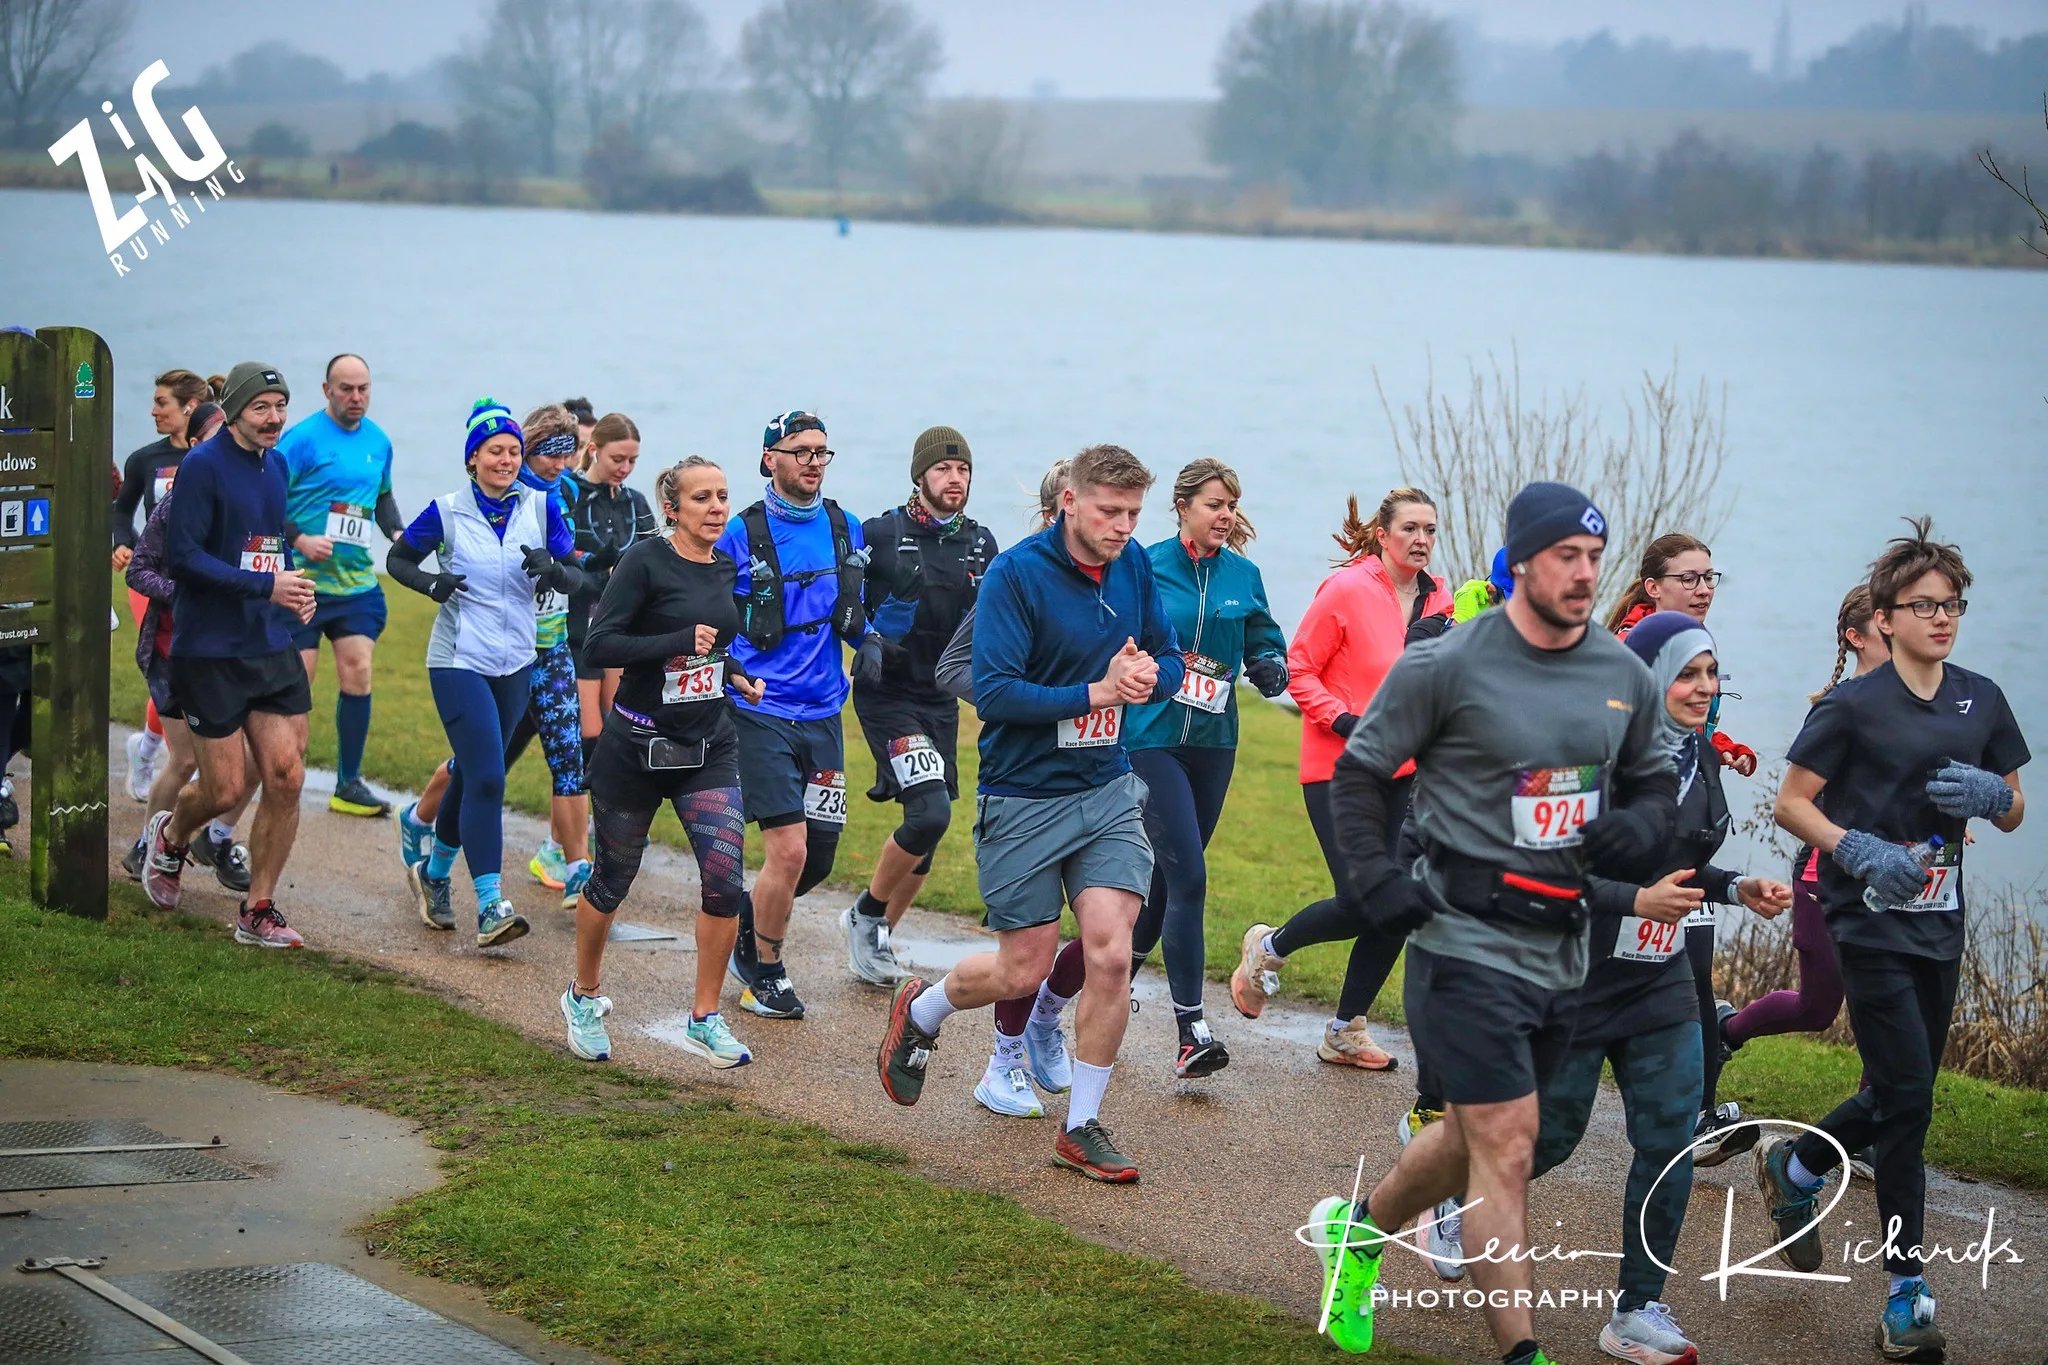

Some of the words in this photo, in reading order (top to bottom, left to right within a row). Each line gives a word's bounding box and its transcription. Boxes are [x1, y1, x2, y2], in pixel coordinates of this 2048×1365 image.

[0, 452, 37, 472] dows
[339, 517, 364, 538] 101
[677, 666, 714, 695] 933
[1074, 708, 1116, 739] 928
[904, 751, 939, 777] 209
[816, 789, 847, 815] 238
[1534, 798, 1585, 837] 924
[1637, 920, 1677, 952] 942
